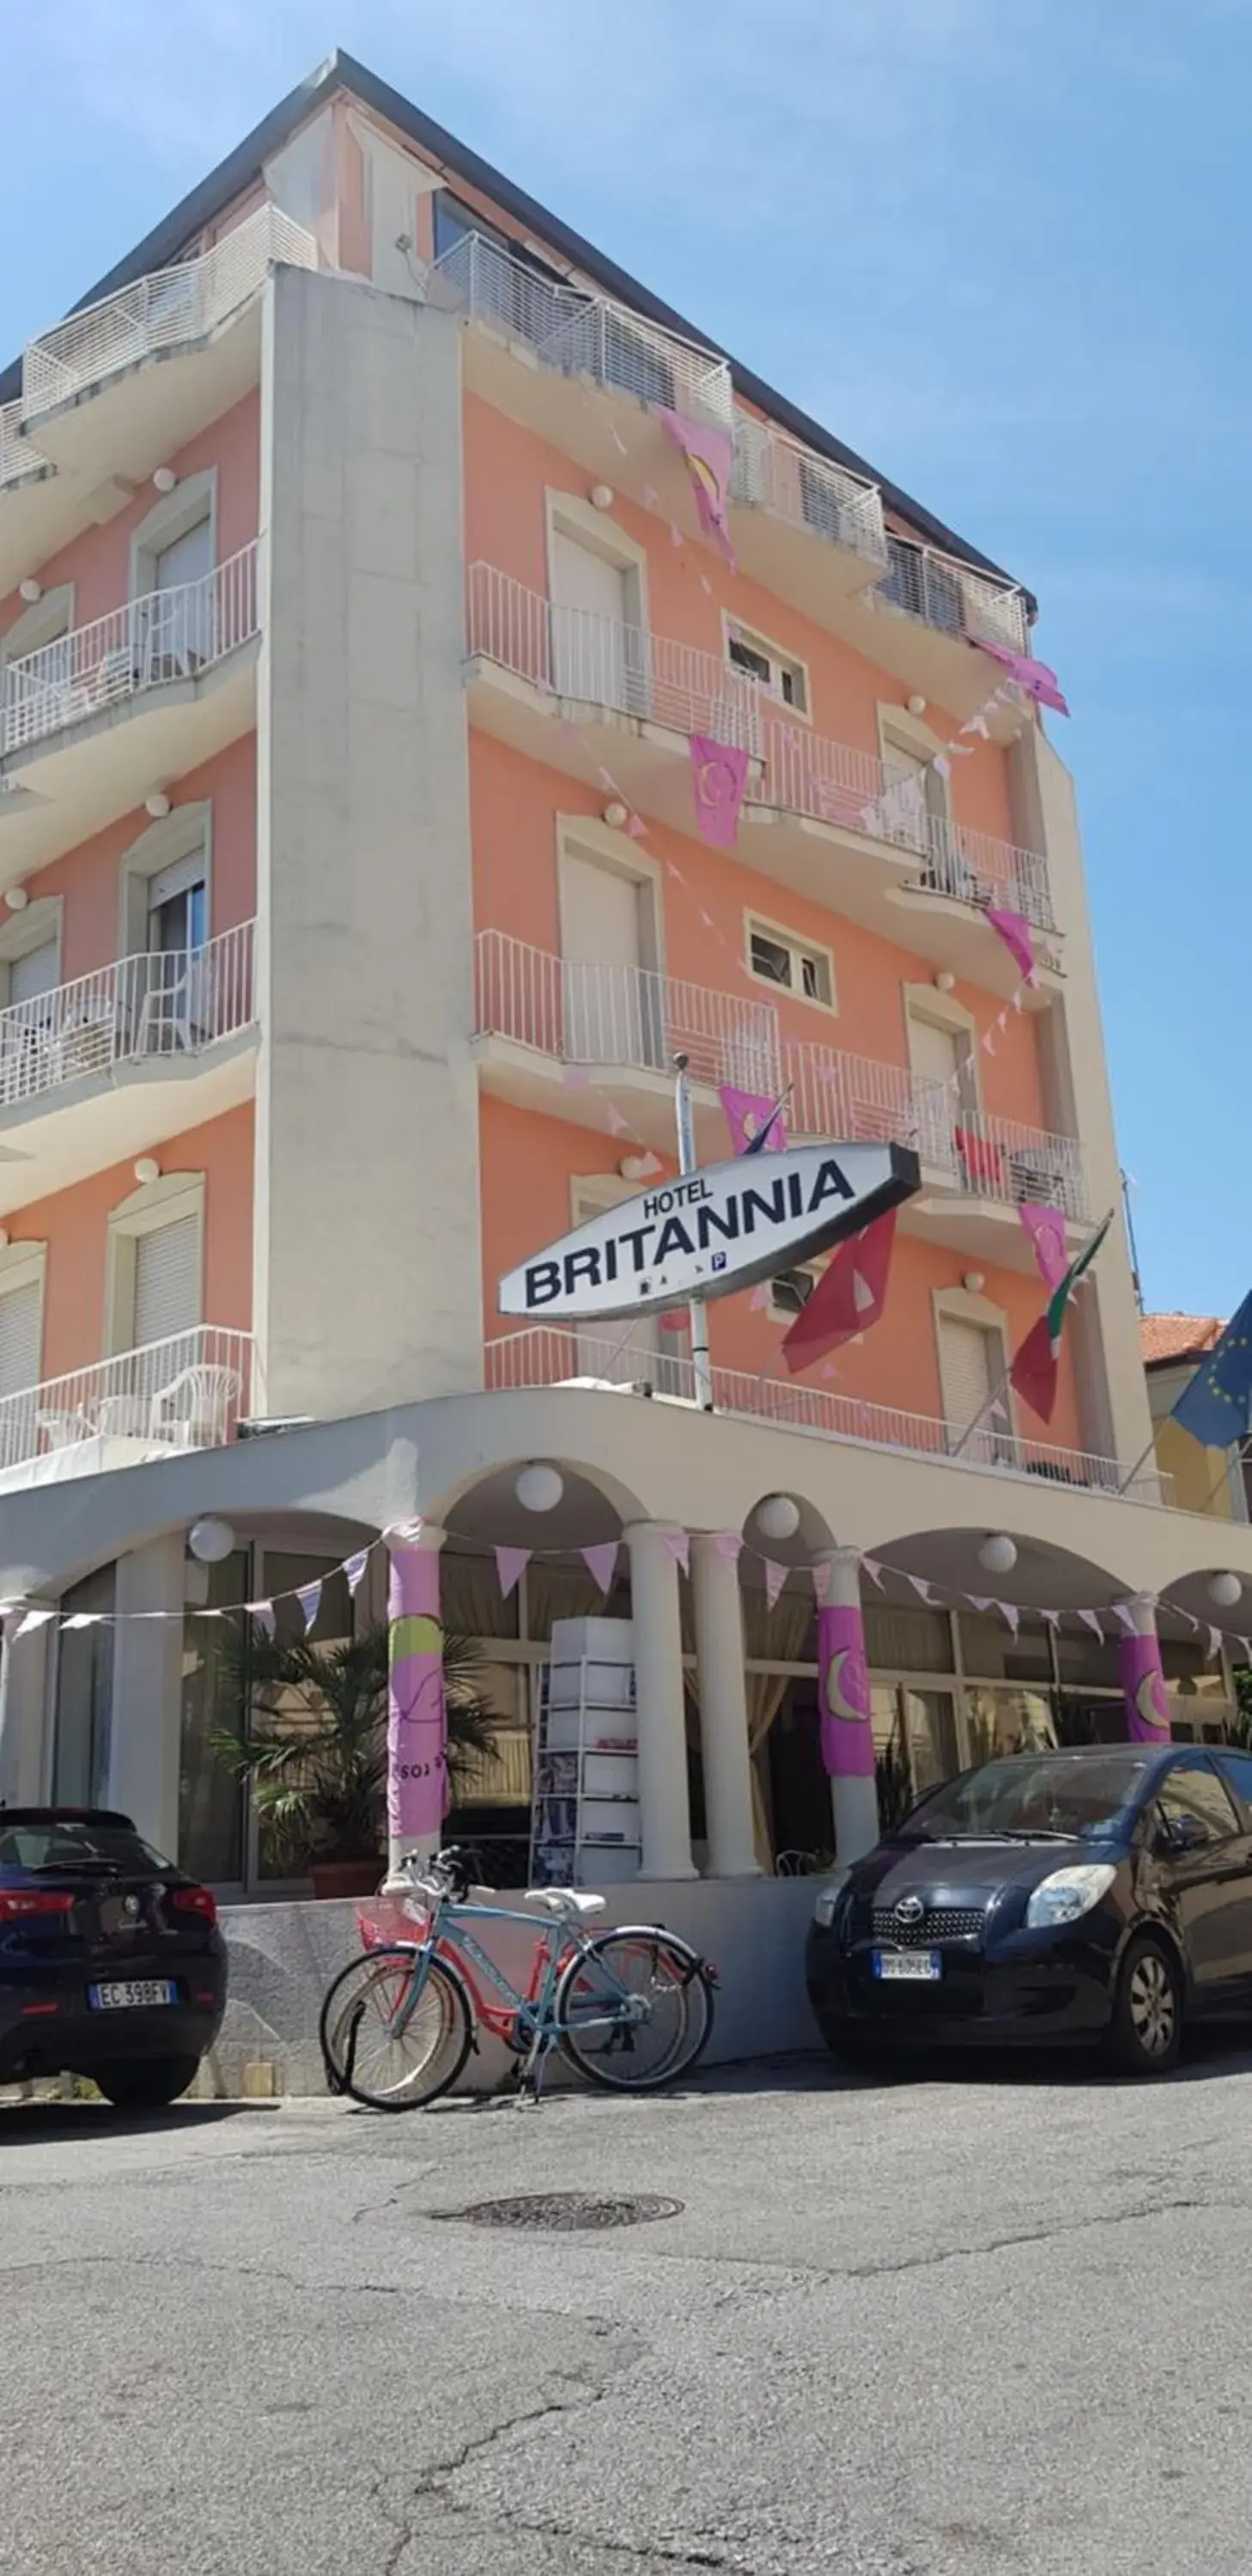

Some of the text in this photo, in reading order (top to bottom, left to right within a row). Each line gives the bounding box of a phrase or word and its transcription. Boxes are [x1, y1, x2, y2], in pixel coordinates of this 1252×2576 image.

[643, 1178, 713, 1219] HOTEL
[525, 1159, 855, 1308] BRITANNIA
[713, 1253, 725, 1270] P
[100, 1984, 120, 2005] EC
